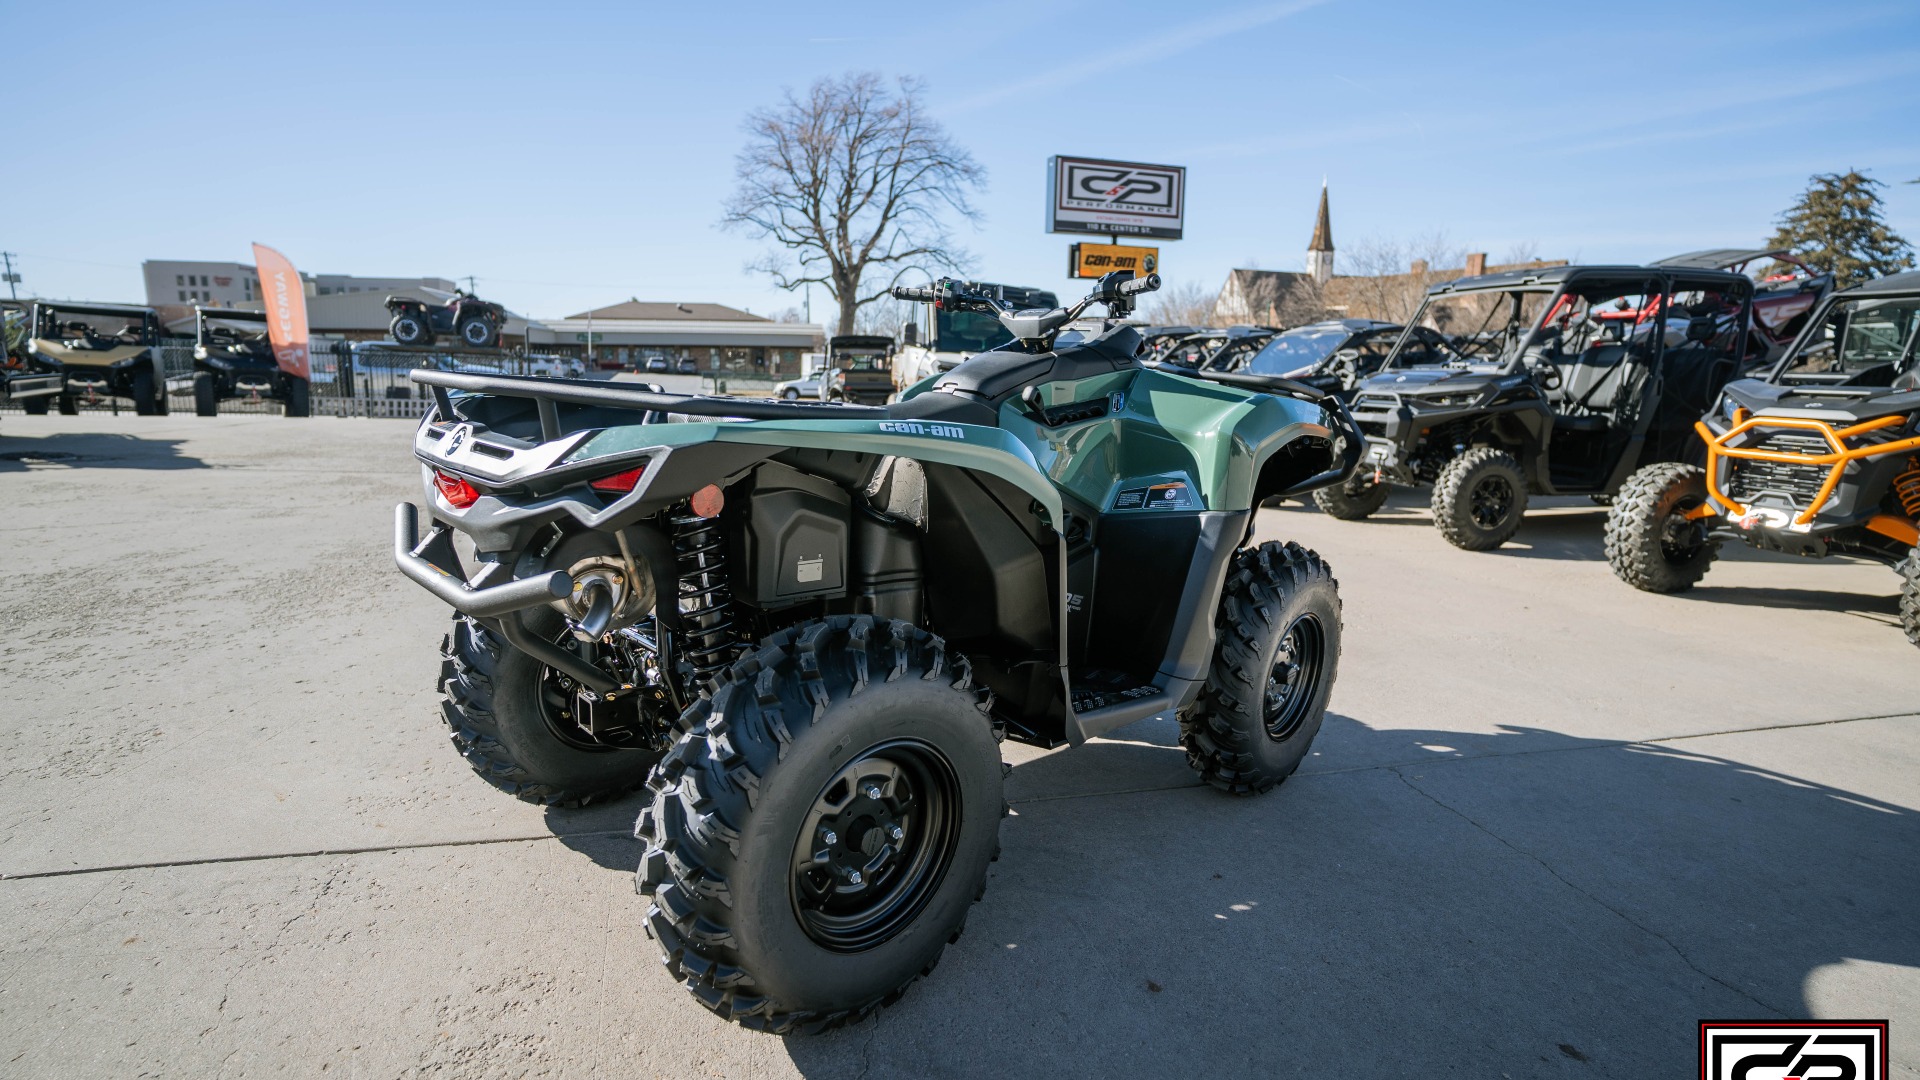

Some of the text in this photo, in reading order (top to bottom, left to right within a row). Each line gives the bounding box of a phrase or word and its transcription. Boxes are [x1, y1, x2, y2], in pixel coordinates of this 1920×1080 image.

[1066, 200, 1173, 213] PERFORMANCE
[1084, 254, 1137, 268] can-am
[879, 422, 965, 439] can-am
